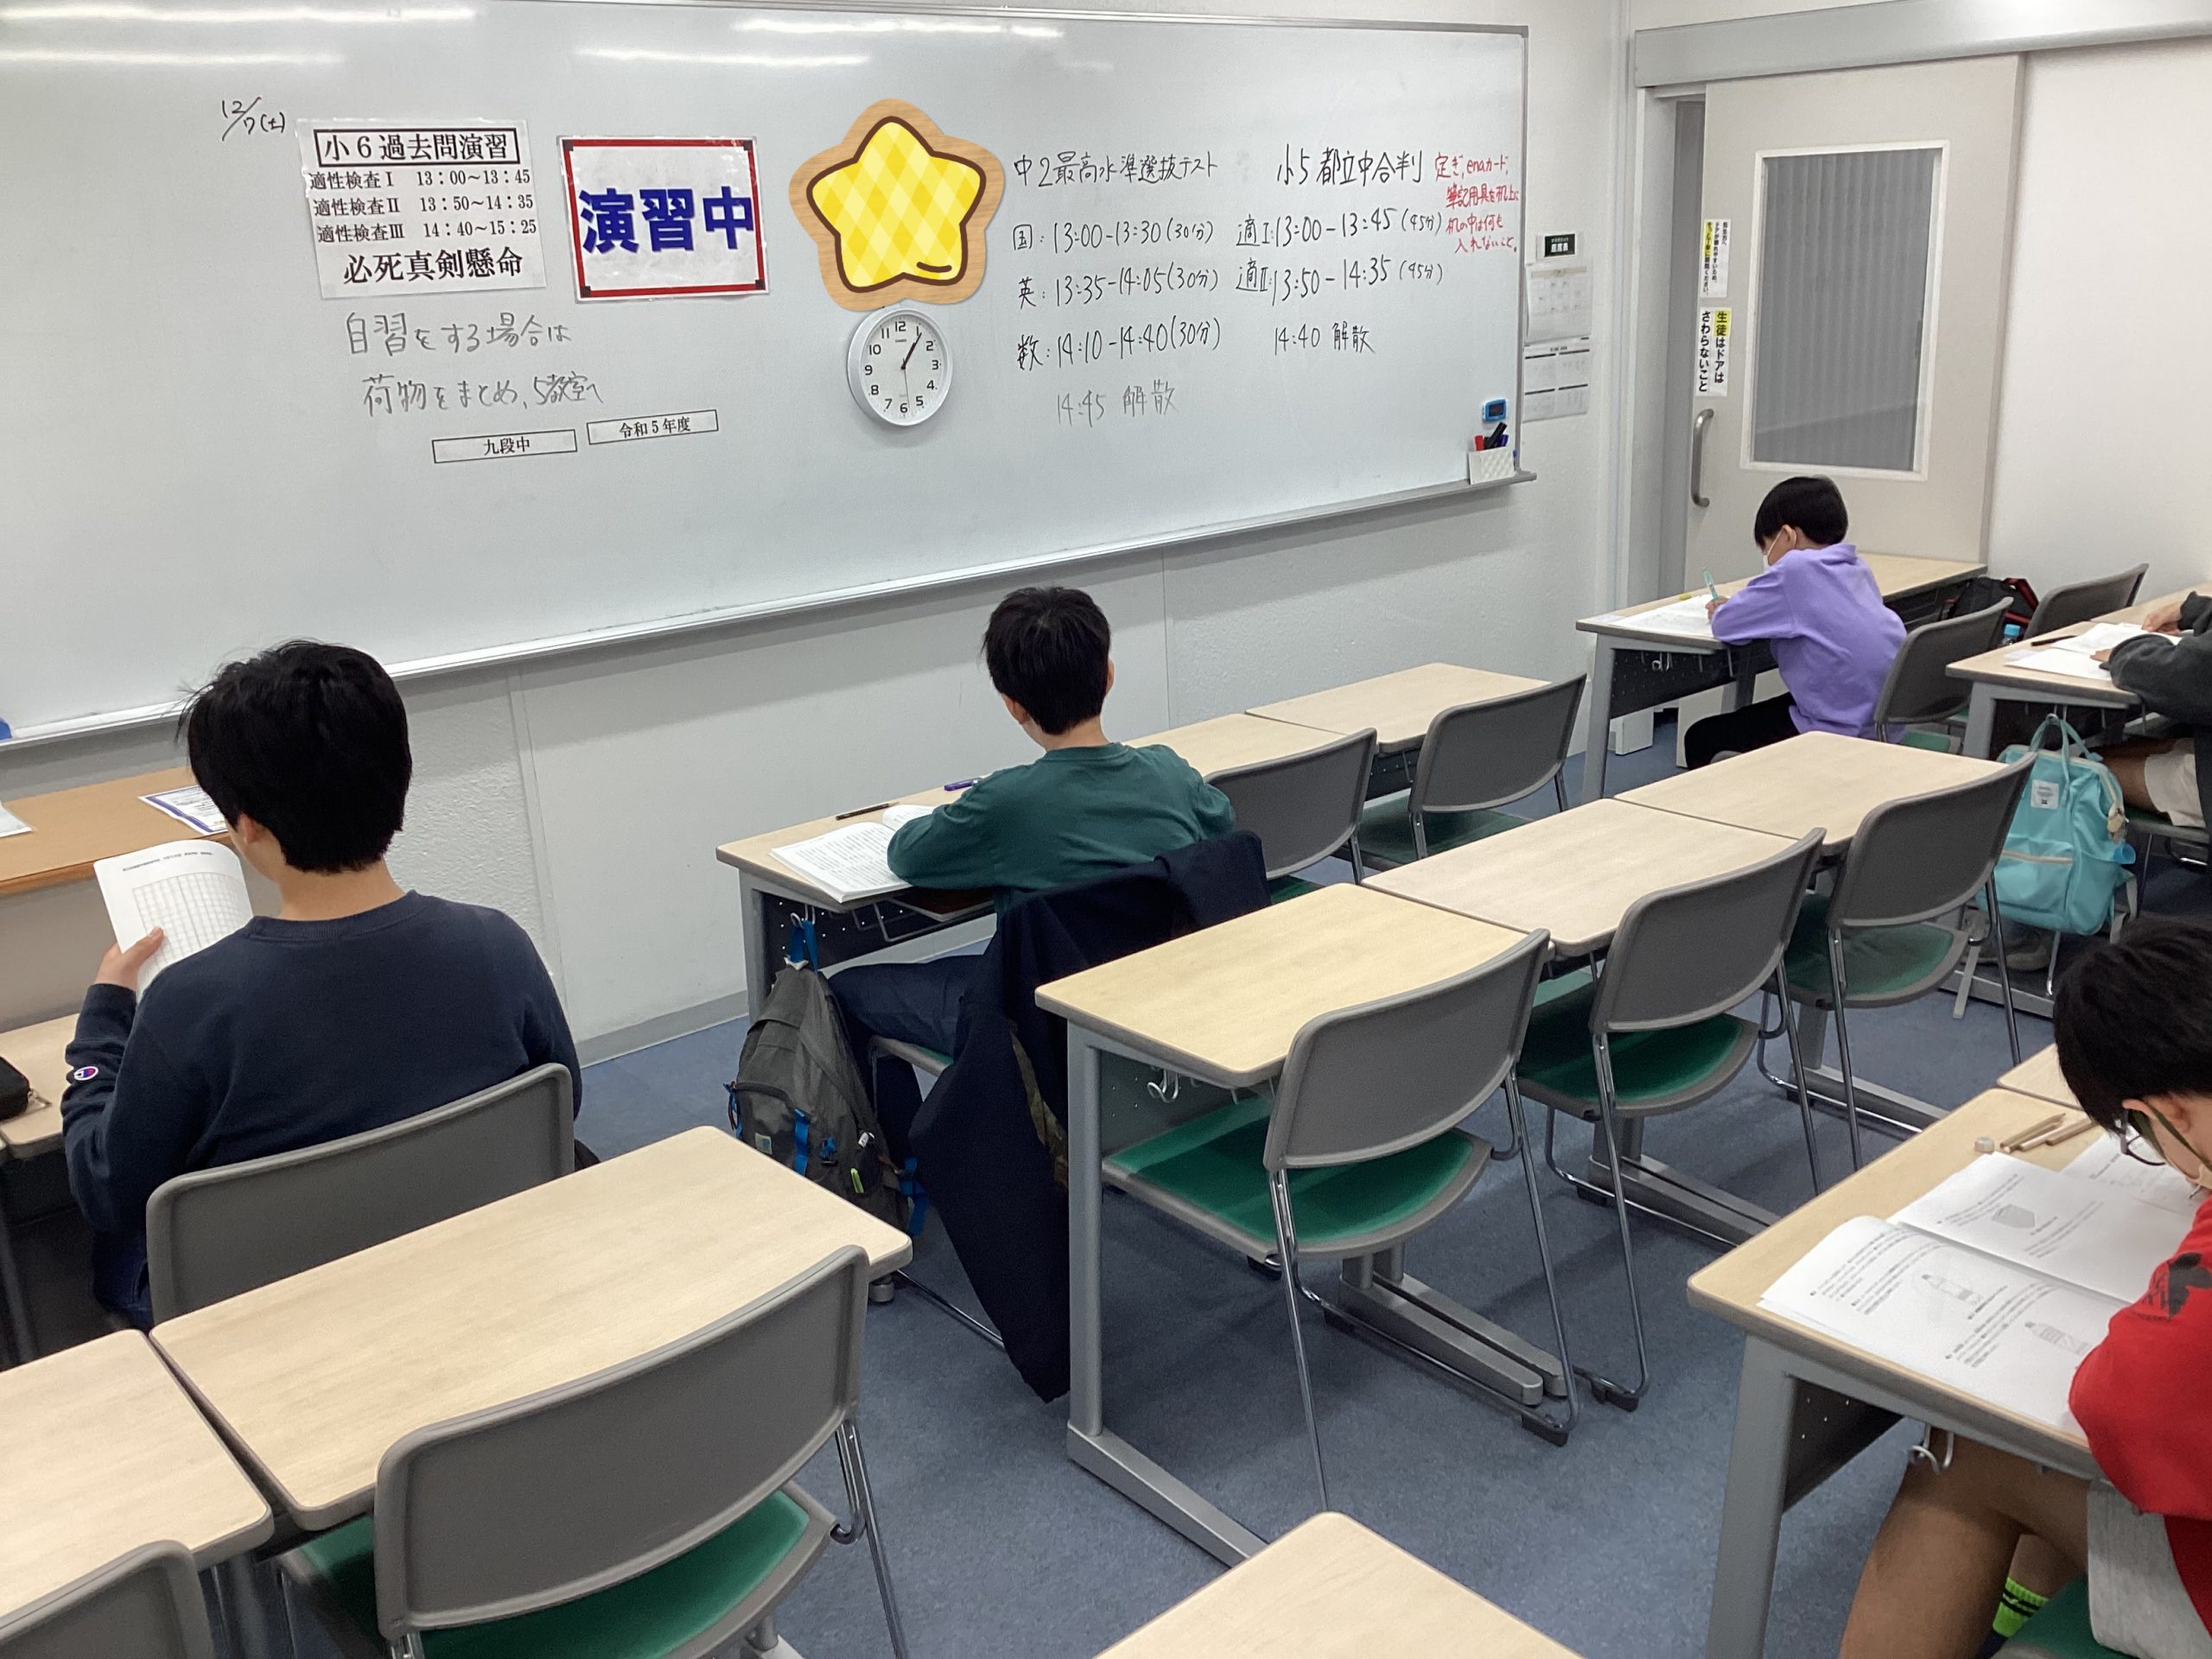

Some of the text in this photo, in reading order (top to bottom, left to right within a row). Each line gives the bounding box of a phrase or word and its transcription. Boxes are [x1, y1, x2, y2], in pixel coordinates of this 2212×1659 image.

[324, 133, 507, 162] 小6過去問演習
[579, 186, 754, 254] 演習中
[343, 246, 524, 285] 必死真剣懸命
[894, 321, 906, 332] 12
[346, 312, 572, 357] 自習をする場合は
[881, 327, 889, 339] 11
[1274, 321, 1376, 356] 14:40 解散
[869, 344, 881, 355] 10
[925, 340, 934, 352] 2
[1698, 310, 1711, 392] さわらないこと
[1714, 310, 1728, 384] 生徒はドアは
[864, 365, 873, 376] 9
[931, 359, 939, 371] 3
[871, 385, 879, 395] 8
[926, 380, 935, 390] 4
[885, 398, 893, 410] 7
[916, 396, 924, 406] 5
[1058, 378, 1179, 428] 14:45 解散
[899, 403, 908, 413] 6
[620, 416, 691, 439] 令和5年度
[484, 436, 531, 456] 九段中
